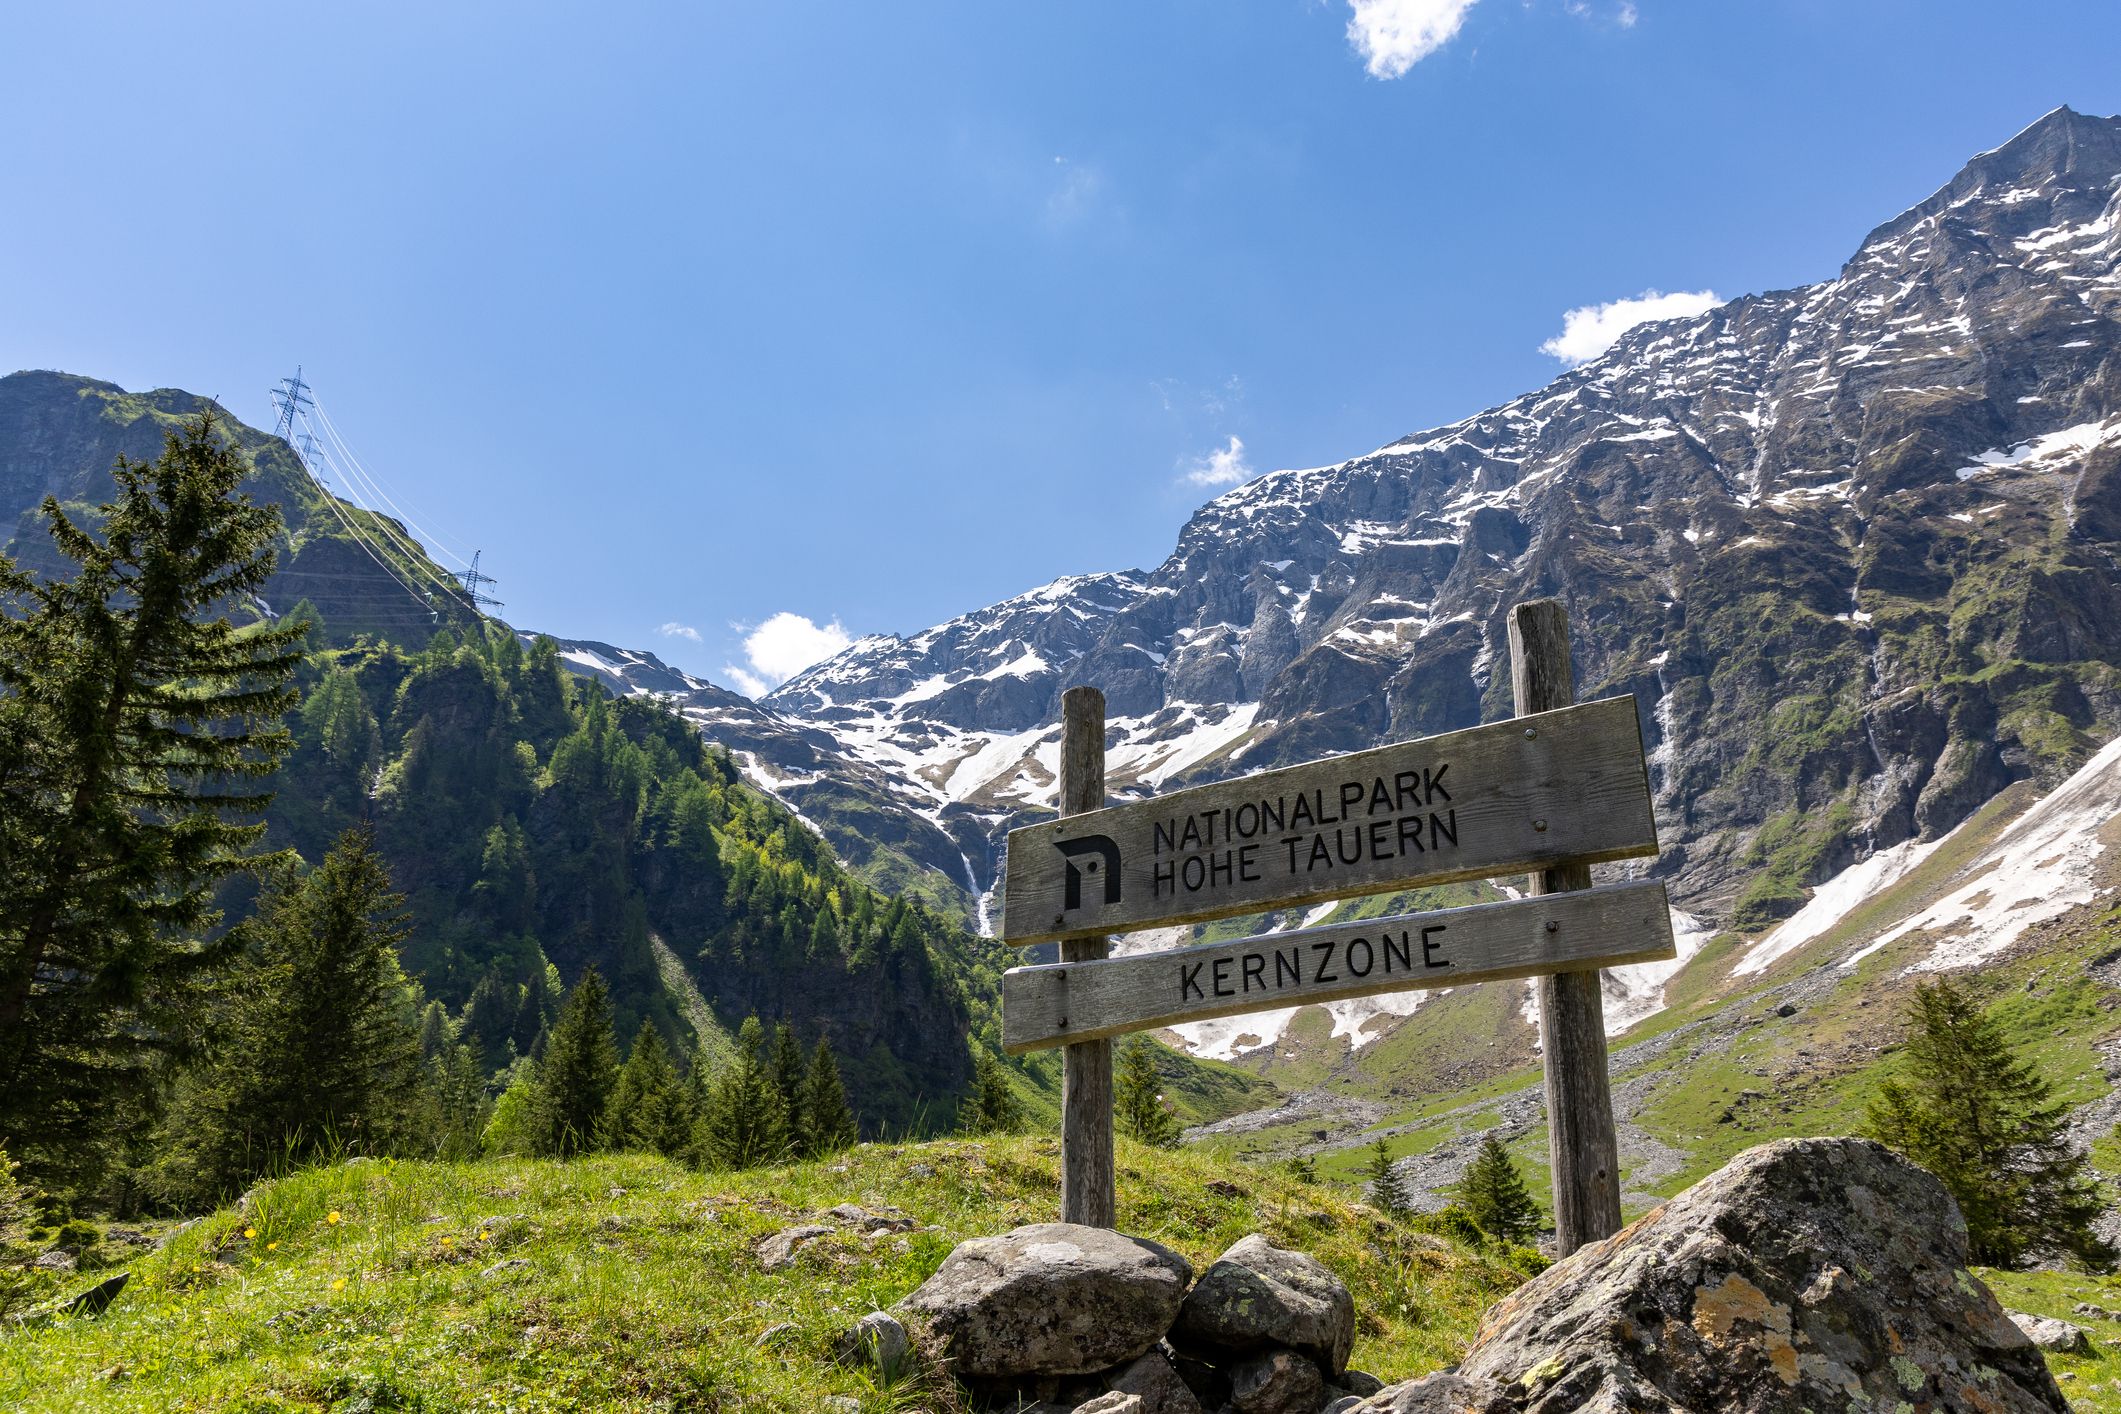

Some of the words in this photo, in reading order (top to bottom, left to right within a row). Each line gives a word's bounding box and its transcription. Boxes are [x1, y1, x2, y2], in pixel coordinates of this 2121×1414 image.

[1154, 763, 1452, 856] NATIONALPARK
[1153, 843, 1260, 896] HOHE
[1281, 810, 1458, 874] TAUERN
[1182, 925, 1450, 1001] KERNZONE
